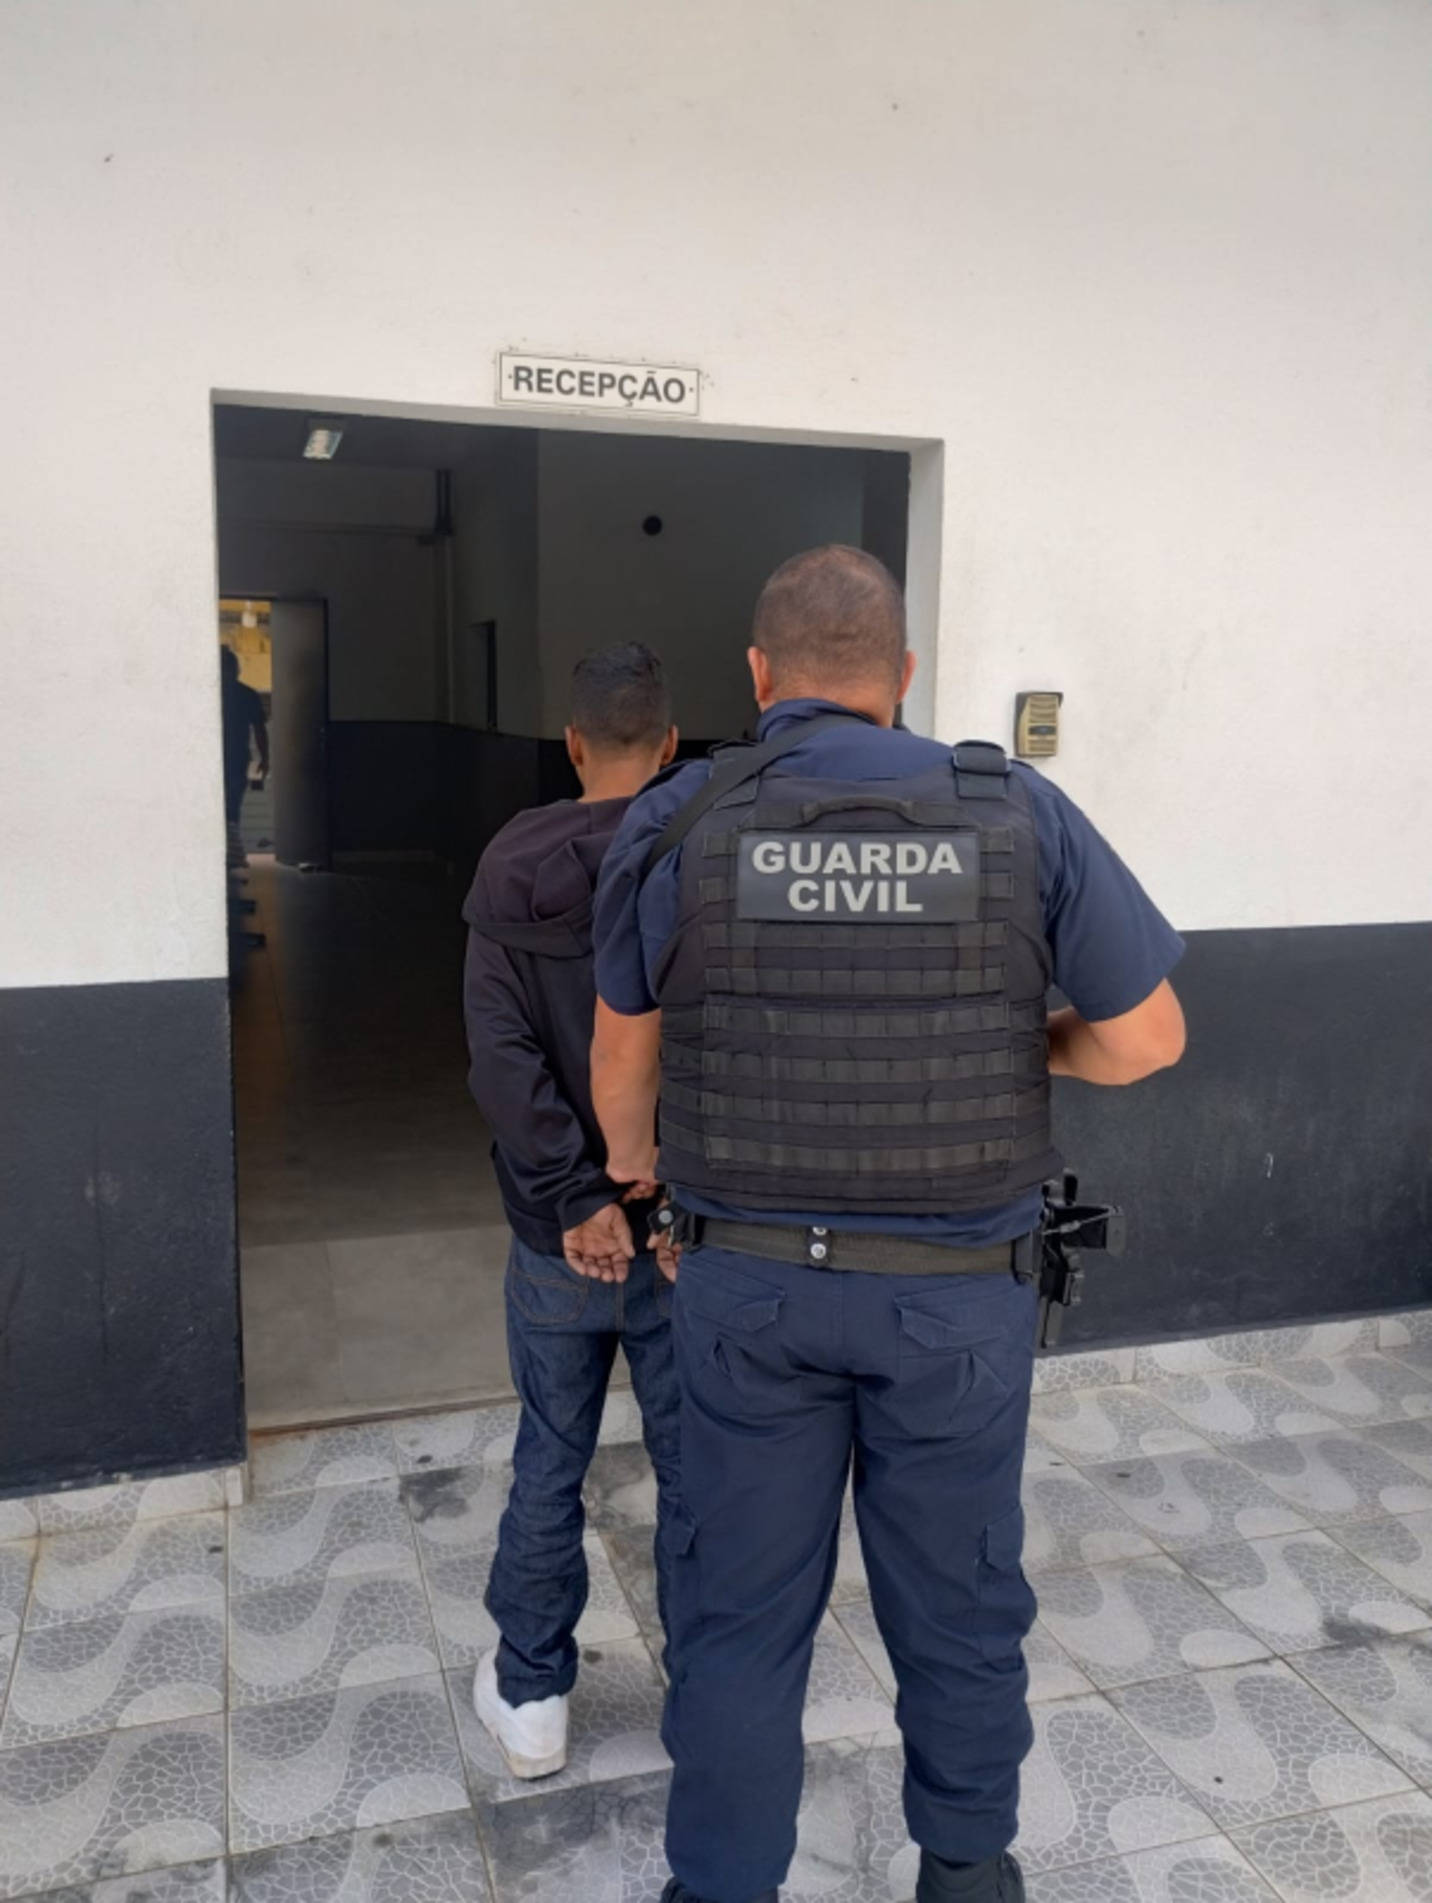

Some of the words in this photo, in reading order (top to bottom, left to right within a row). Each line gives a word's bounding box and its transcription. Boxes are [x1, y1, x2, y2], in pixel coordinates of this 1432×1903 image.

[514, 365, 686, 407] RECEPÇÃO
[752, 841, 963, 875] GUARDA
[787, 879, 923, 912] CIVIL
